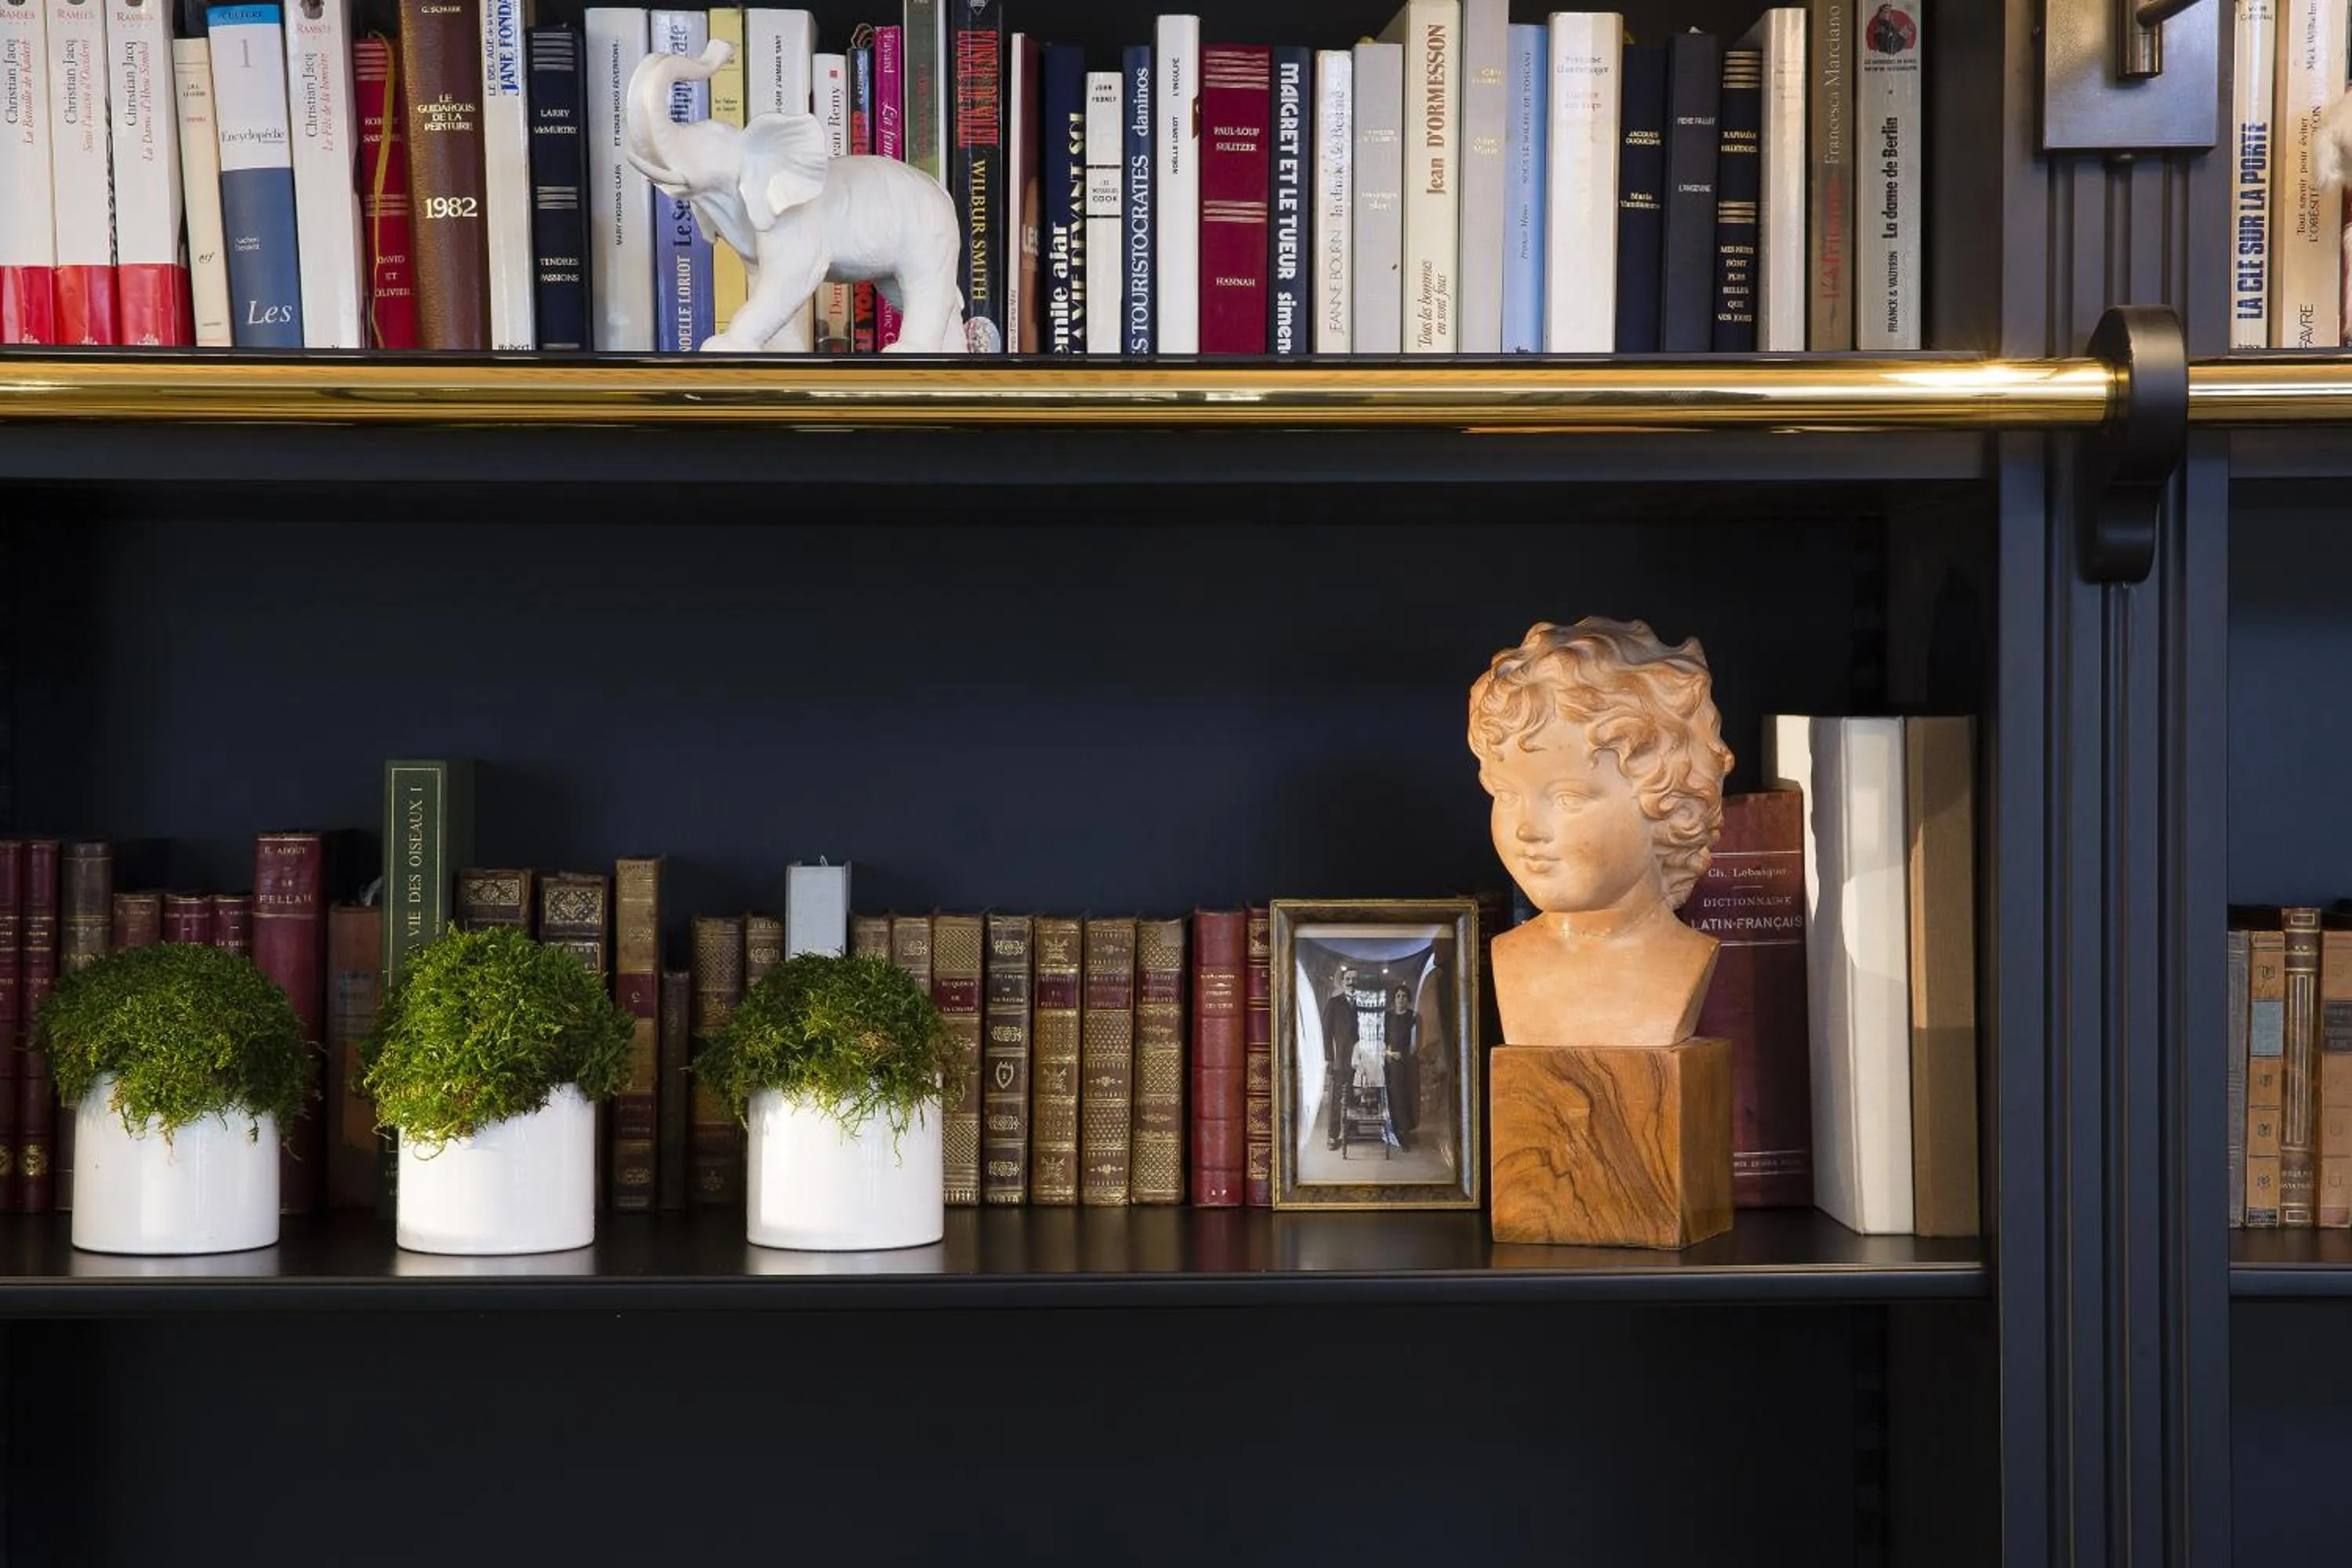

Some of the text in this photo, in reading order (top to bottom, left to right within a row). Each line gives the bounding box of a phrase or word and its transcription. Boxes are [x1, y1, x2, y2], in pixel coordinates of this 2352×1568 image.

[4, 39, 20, 124] Christian Jacq
[63, 40, 78, 124] Christian Jacq
[123, 42, 136, 126] Christian Jacq
[499, 52, 519, 94] JANE
[1825, 5, 1843, 164] Francesca Marciano
[303, 53, 318, 137] Christian Jacq
[439, 94, 452, 103] LE
[882, 101, 898, 125] La
[1132, 67, 1149, 136] daninos
[1426, 24, 1446, 194] Jean D'ORMESSON
[424, 122, 474, 131] PEINTURE
[432, 113, 462, 122] DE LA
[541, 109, 570, 118] LARRY
[957, 107, 998, 149] SOLEIL
[1214, 126, 1260, 136] PAUL-LOUP
[222, 128, 285, 143] Encyclopédie
[614, 136, 621, 147] ET
[832, 132, 841, 157] ean
[2241, 123, 2267, 183] PORTE
[1278, 63, 1298, 280] MAIGRET ET LE TUEUR
[1882, 117, 1898, 238] La dame de Berlin
[2297, 118, 2308, 235] Tout savoir pour éviter
[425, 197, 477, 219] 1982
[1069, 112, 1086, 321] VIE DEVANT SOI
[2240, 188, 2266, 210] LA
[673, 227, 691, 247] Le
[971, 159, 986, 301] WILBUR SMITH
[1131, 155, 1149, 334] TOURISTOCRATES
[2239, 216, 2265, 255] SUR
[539, 258, 579, 267] TENDRES
[1050, 221, 1069, 279] ajar
[677, 256, 691, 303] LORIOT
[1216, 278, 1255, 287] HANNAH
[1330, 230, 1344, 335] JEANNE BOURIN
[1888, 251, 1897, 287] VAUTRIN
[248, 300, 292, 325] Les
[1417, 260, 1433, 350] Tous les hommes
[1435, 274, 1450, 336] en sont fous
[1727, 300, 1744, 309] QUE
[1888, 299, 1897, 332] FRANCK
[2237, 297, 2263, 319] LA
[408, 800, 423, 866] OISEAUX
[408, 874, 421, 902] DES
[1708, 869, 1727, 878] Ch.
[1704, 896, 1792, 908] DICTIONNAIRE
[407, 910, 421, 937] VIE
[1691, 916, 1803, 931] LATIN-FRANÇAIS
